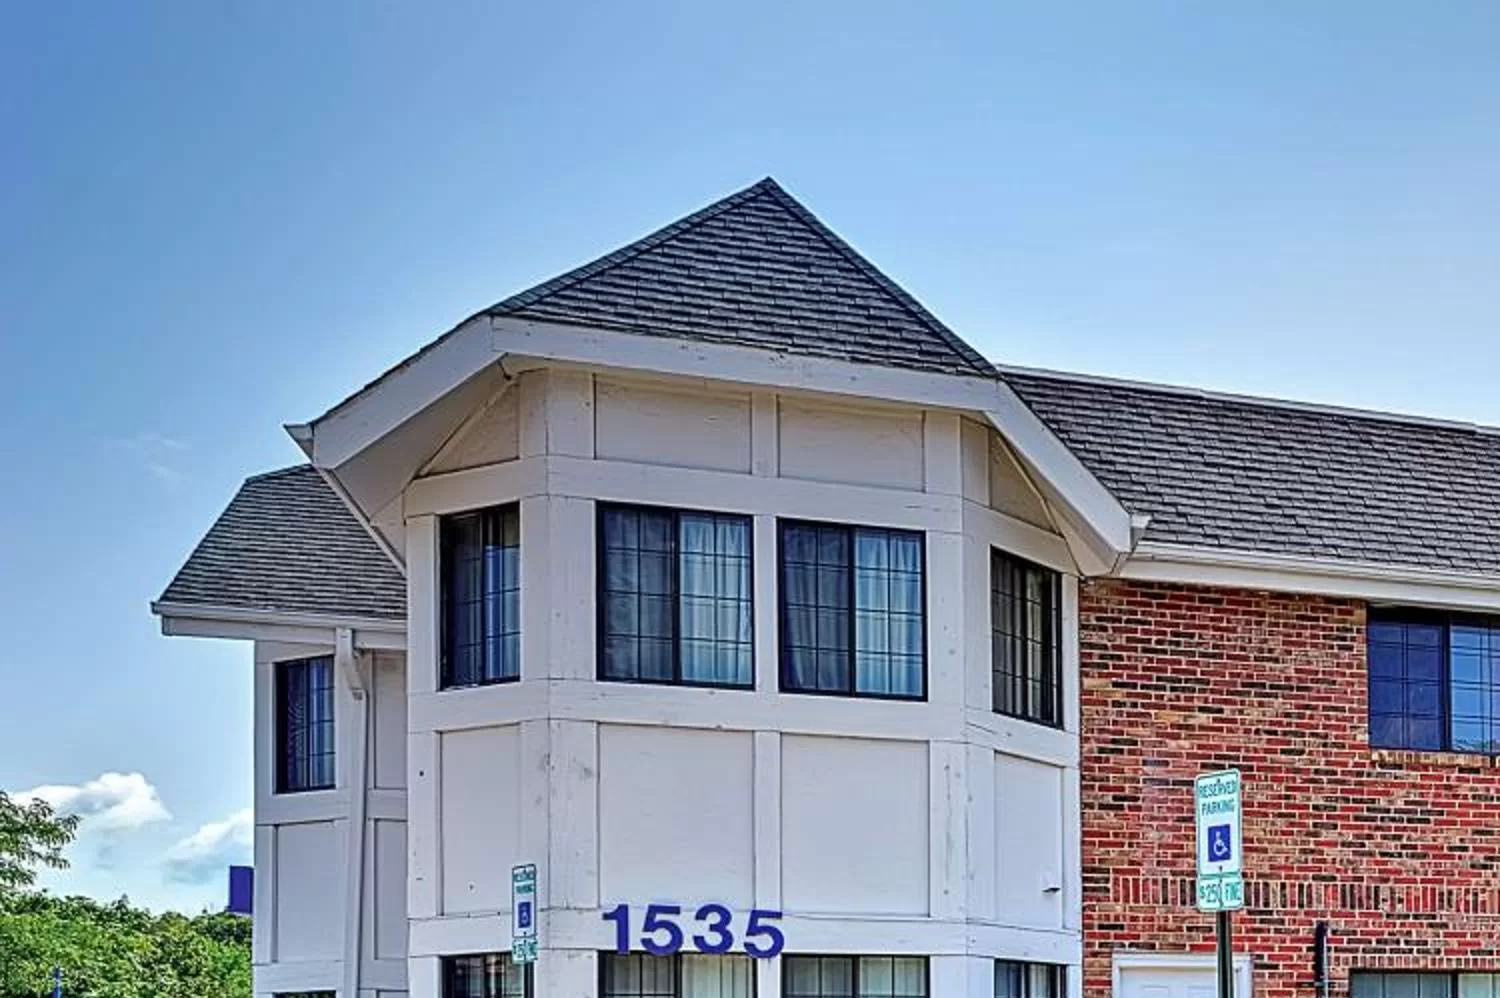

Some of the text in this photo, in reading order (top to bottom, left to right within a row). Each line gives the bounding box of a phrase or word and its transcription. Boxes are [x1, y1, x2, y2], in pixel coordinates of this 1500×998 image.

[1199, 780, 1237, 798] RESERVED
[1201, 798, 1235, 816] PARKING
[602, 904, 785, 959] 1535
